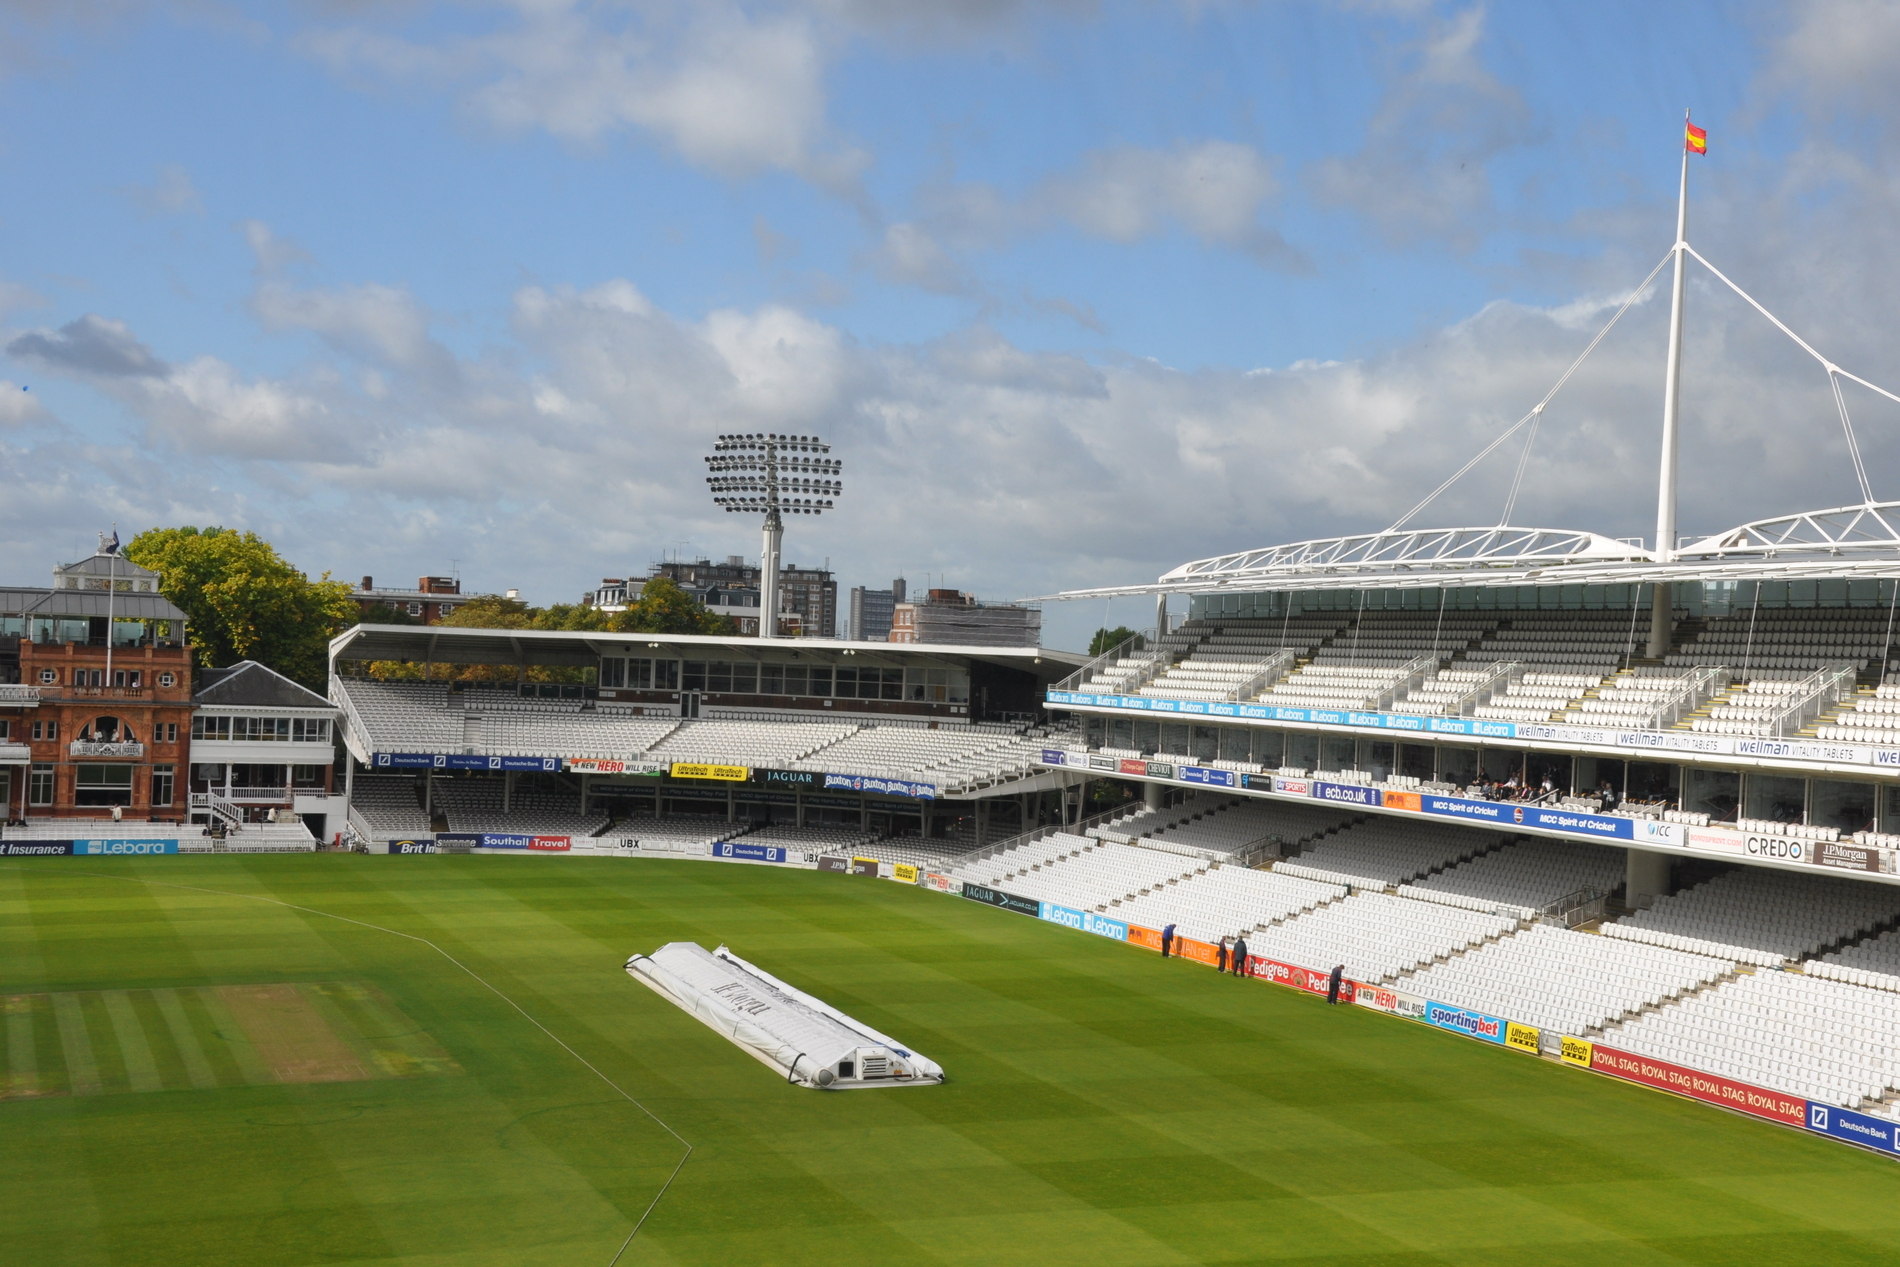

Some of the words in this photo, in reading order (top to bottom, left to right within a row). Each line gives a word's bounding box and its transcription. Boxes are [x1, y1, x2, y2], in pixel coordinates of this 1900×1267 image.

[1184, 702, 1203, 712] Lebara
[1214, 704, 1234, 714] Lebara
[1244, 707, 1266, 717] Lebara
[1282, 710, 1304, 720] Lebara
[1316, 712, 1338, 722] Lebara
[1354, 714, 1379, 726] Lebara
[1393, 716, 1418, 728] Lebara
[1438, 720, 1464, 733] Lebara
[1480, 723, 1508, 736] Lebara
[1518, 726, 1556, 738] wellman
[1557, 730, 1579, 740] VITALITY
[1580, 732, 1603, 742] TABLETS
[1620, 733, 1664, 746] wellman
[1666, 737, 1690, 748] VITALITY
[1692, 739, 1718, 750] TABLETS
[1740, 741, 1789, 756] wellman
[1792, 746, 1820, 757] VITALITY
[1823, 747, 1854, 760] TABLETS
[597, 761, 624, 772] HERO
[1148, 763, 1170, 774] CHEVIOT
[768, 771, 812, 782] JAGUAR
[825, 775, 851, 788] Buxton
[863, 779, 887, 791] Buxton
[887, 781, 909, 794] Buxton
[916, 785, 934, 798] Buxton
[1285, 782, 1306, 792] SPORTS
[1325, 786, 1366, 802] ecb.co.uk
[1433, 801, 1448, 809] MCC
[1448, 803, 1466, 812] Spirit
[1474, 806, 1498, 816] Cricket
[1540, 814, 1557, 824] MCC
[1558, 817, 1578, 827] Spirit
[1587, 820, 1616, 832] Cricket
[1656, 825, 1671, 837] ICC
[484, 836, 529, 846] Southall
[534, 838, 567, 848] Travel
[620, 839, 639, 848] UBX
[1690, 834, 1742, 847] BONUSPRINT.COM
[8, 844, 65, 854] Insurance
[103, 841, 165, 854] Lebara
[401, 844, 423, 854] Brit
[1748, 837, 1802, 859] CREDO
[1823, 844, 1867, 862] J.P.Morgan
[803, 853, 819, 863] UBX
[1836, 860, 1866, 869] Management
[937, 875, 949, 889] HERO
[966, 885, 994, 902] JAGUAR
[1008, 899, 1038, 911] JAGUAR.CO.UK
[1050, 904, 1080, 928] Lebara
[1092, 915, 1123, 940] Lebara
[1248, 957, 1289, 981] Pedigree
[1308, 972, 1353, 996] Pediee
[1357, 988, 1361, 998] A
[1362, 990, 1374, 1002] NEW
[1374, 990, 1396, 1009] HERO
[1397, 1000, 1410, 1011] WILL
[1412, 1003, 1424, 1015] RISE
[1432, 1008, 1498, 1036] sportingbet
[1593, 1052, 1617, 1068] ROYAL
[1619, 1058, 1639, 1073] STAG
[1642, 1065, 1667, 1081] ROYAL
[1670, 1072, 1691, 1087] STAG
[1693, 1078, 1720, 1096] ROYAL
[1722, 1086, 1744, 1102] STAG
[1748, 1093, 1777, 1111] ROYAL
[1780, 1102, 1804, 1118] STAG
[1840, 1118, 1870, 1134] Deutsche
[1871, 1126, 1887, 1140] Bank
